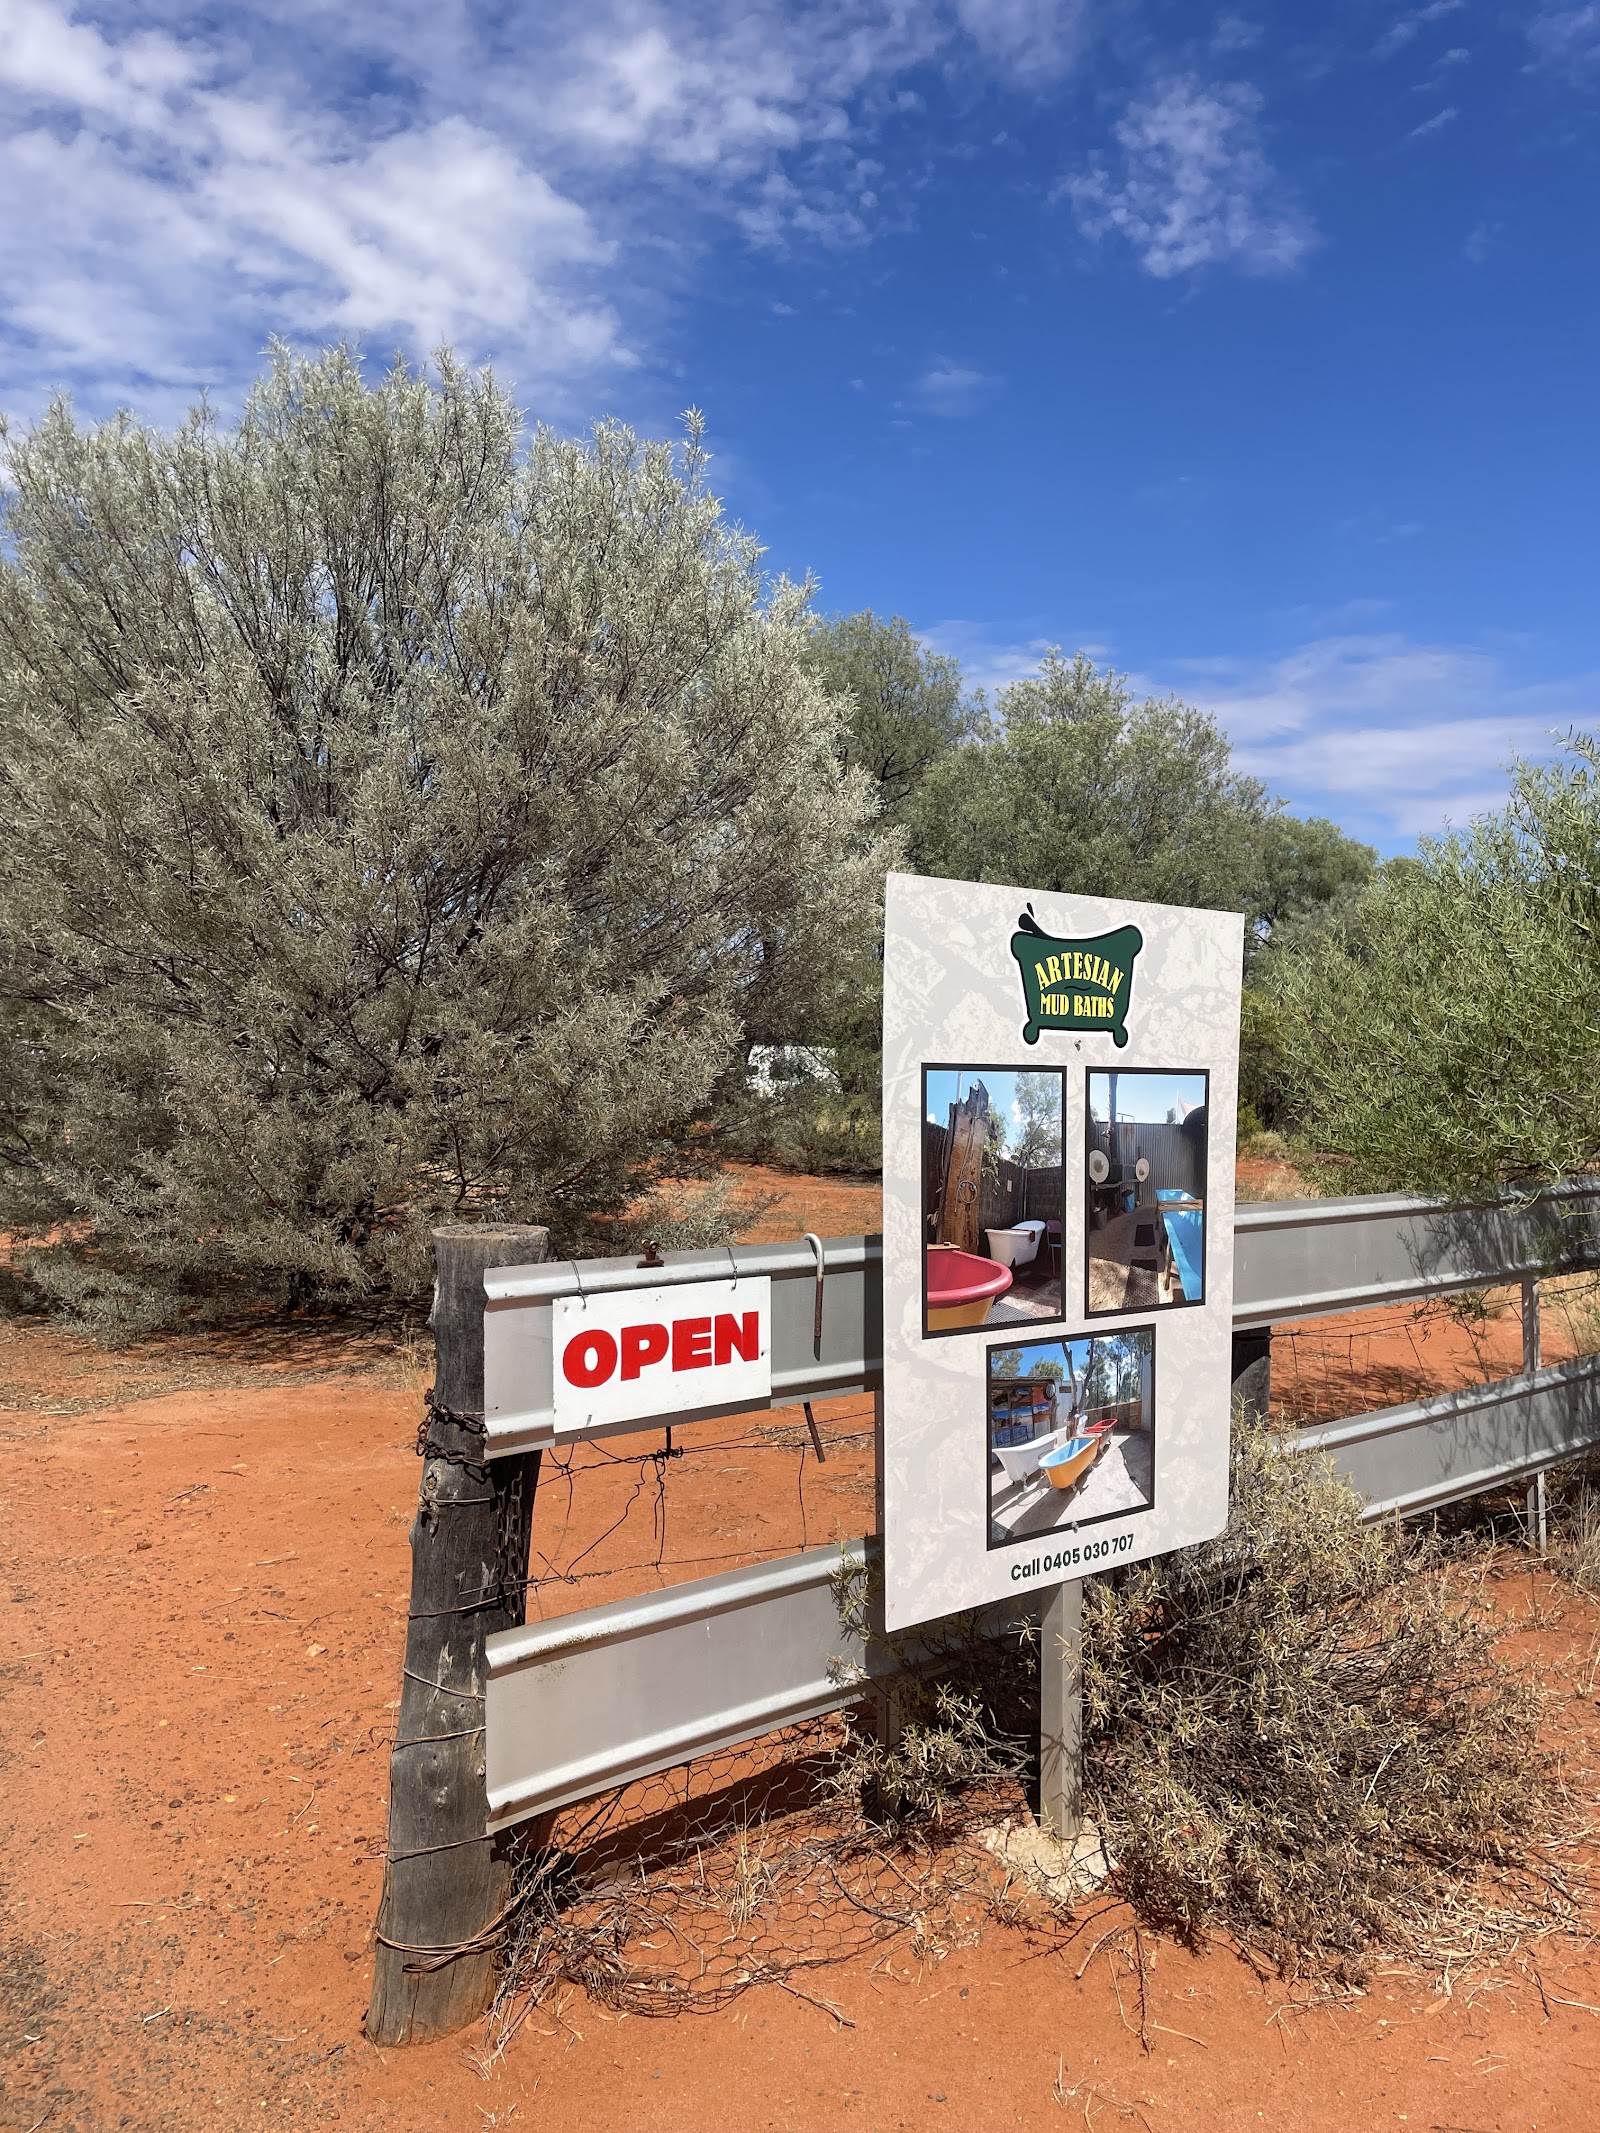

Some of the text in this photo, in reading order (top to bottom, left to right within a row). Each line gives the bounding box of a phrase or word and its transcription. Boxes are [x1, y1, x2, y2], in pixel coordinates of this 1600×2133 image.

[1034, 951, 1125, 995] ARTESIAN
[1040, 993, 1115, 1018] MUD BATHS
[562, 1311, 759, 1389] OPEN
[1011, 1533, 1135, 1581] Call 0405 030 707
